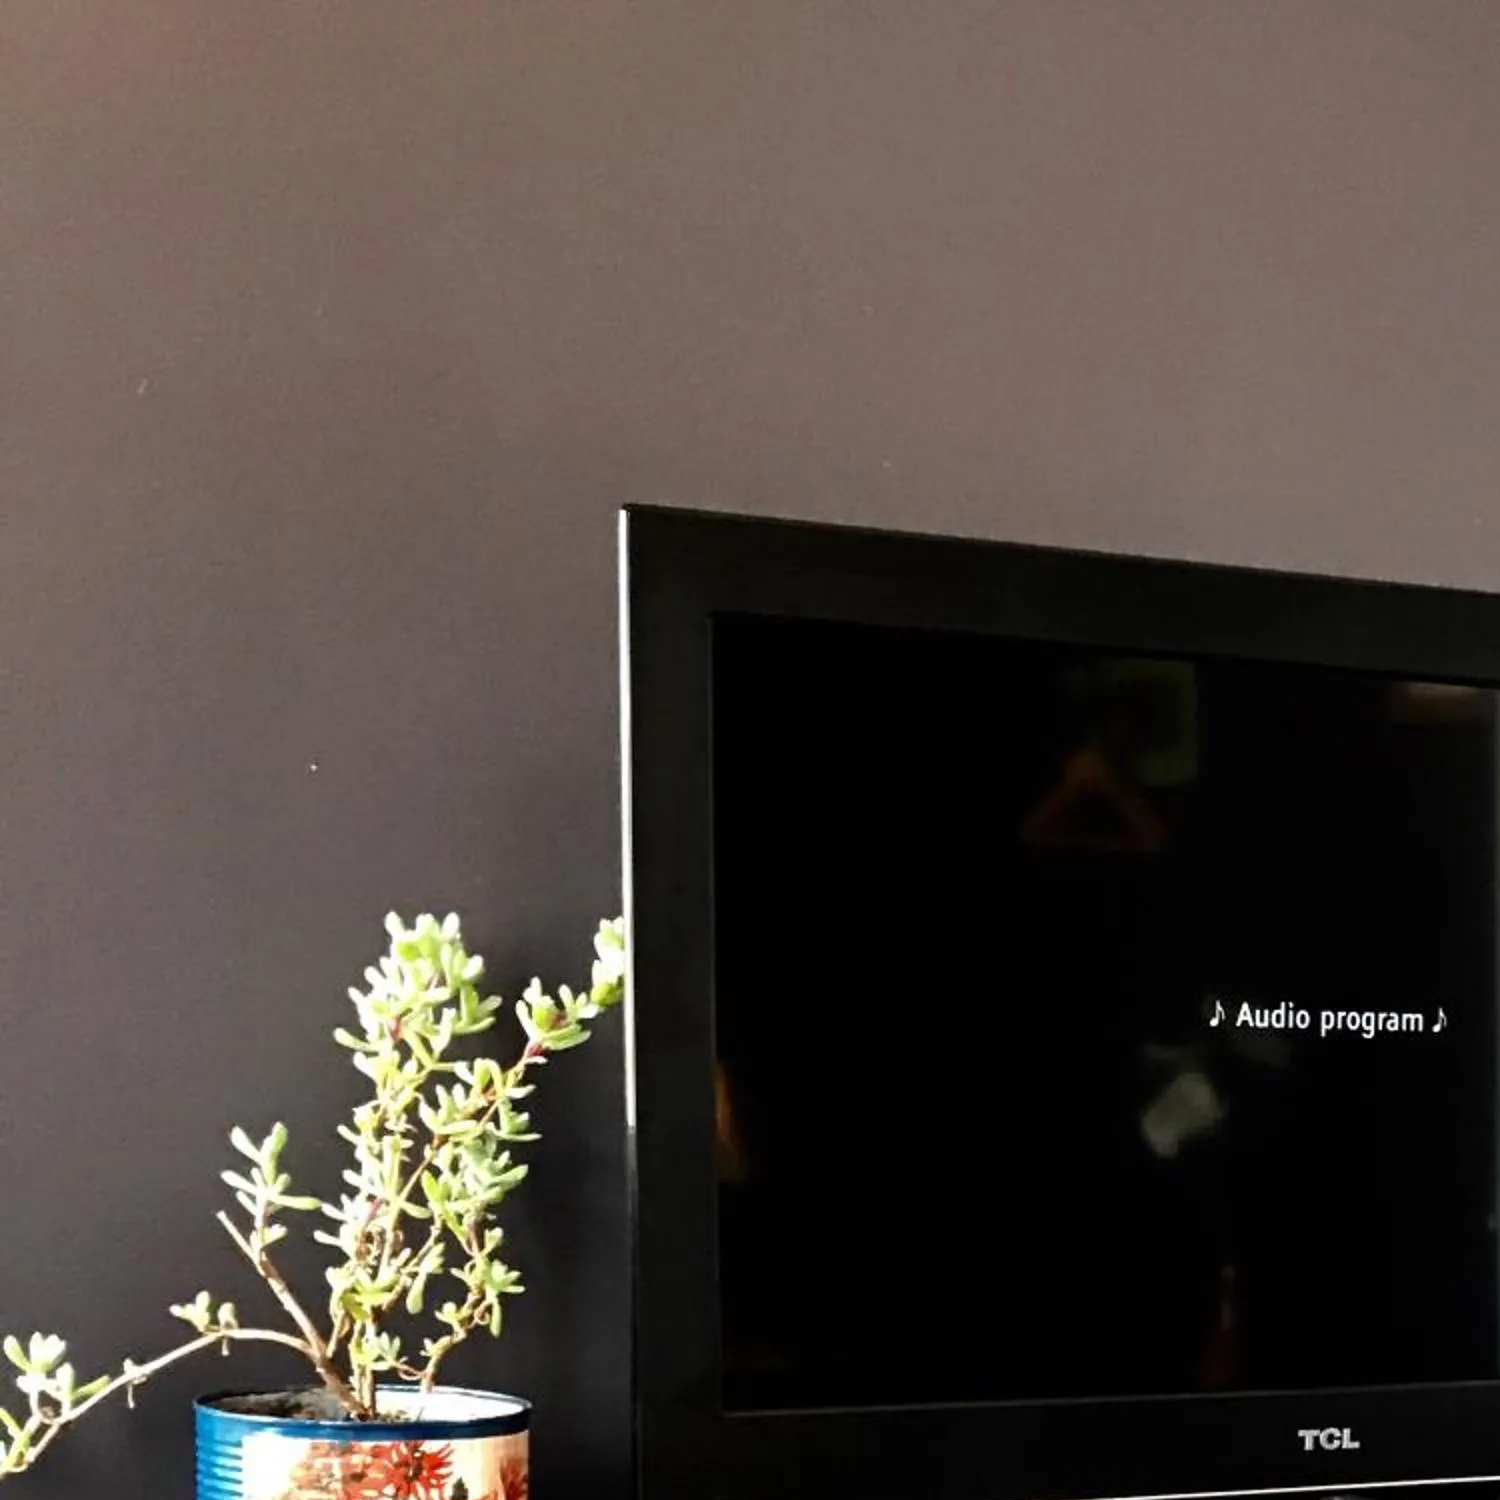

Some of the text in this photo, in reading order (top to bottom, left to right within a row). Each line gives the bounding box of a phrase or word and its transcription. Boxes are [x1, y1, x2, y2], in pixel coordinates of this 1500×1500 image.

[1236, 1001, 1424, 1039] Audio program
[1298, 1427, 1360, 1451] TCL
